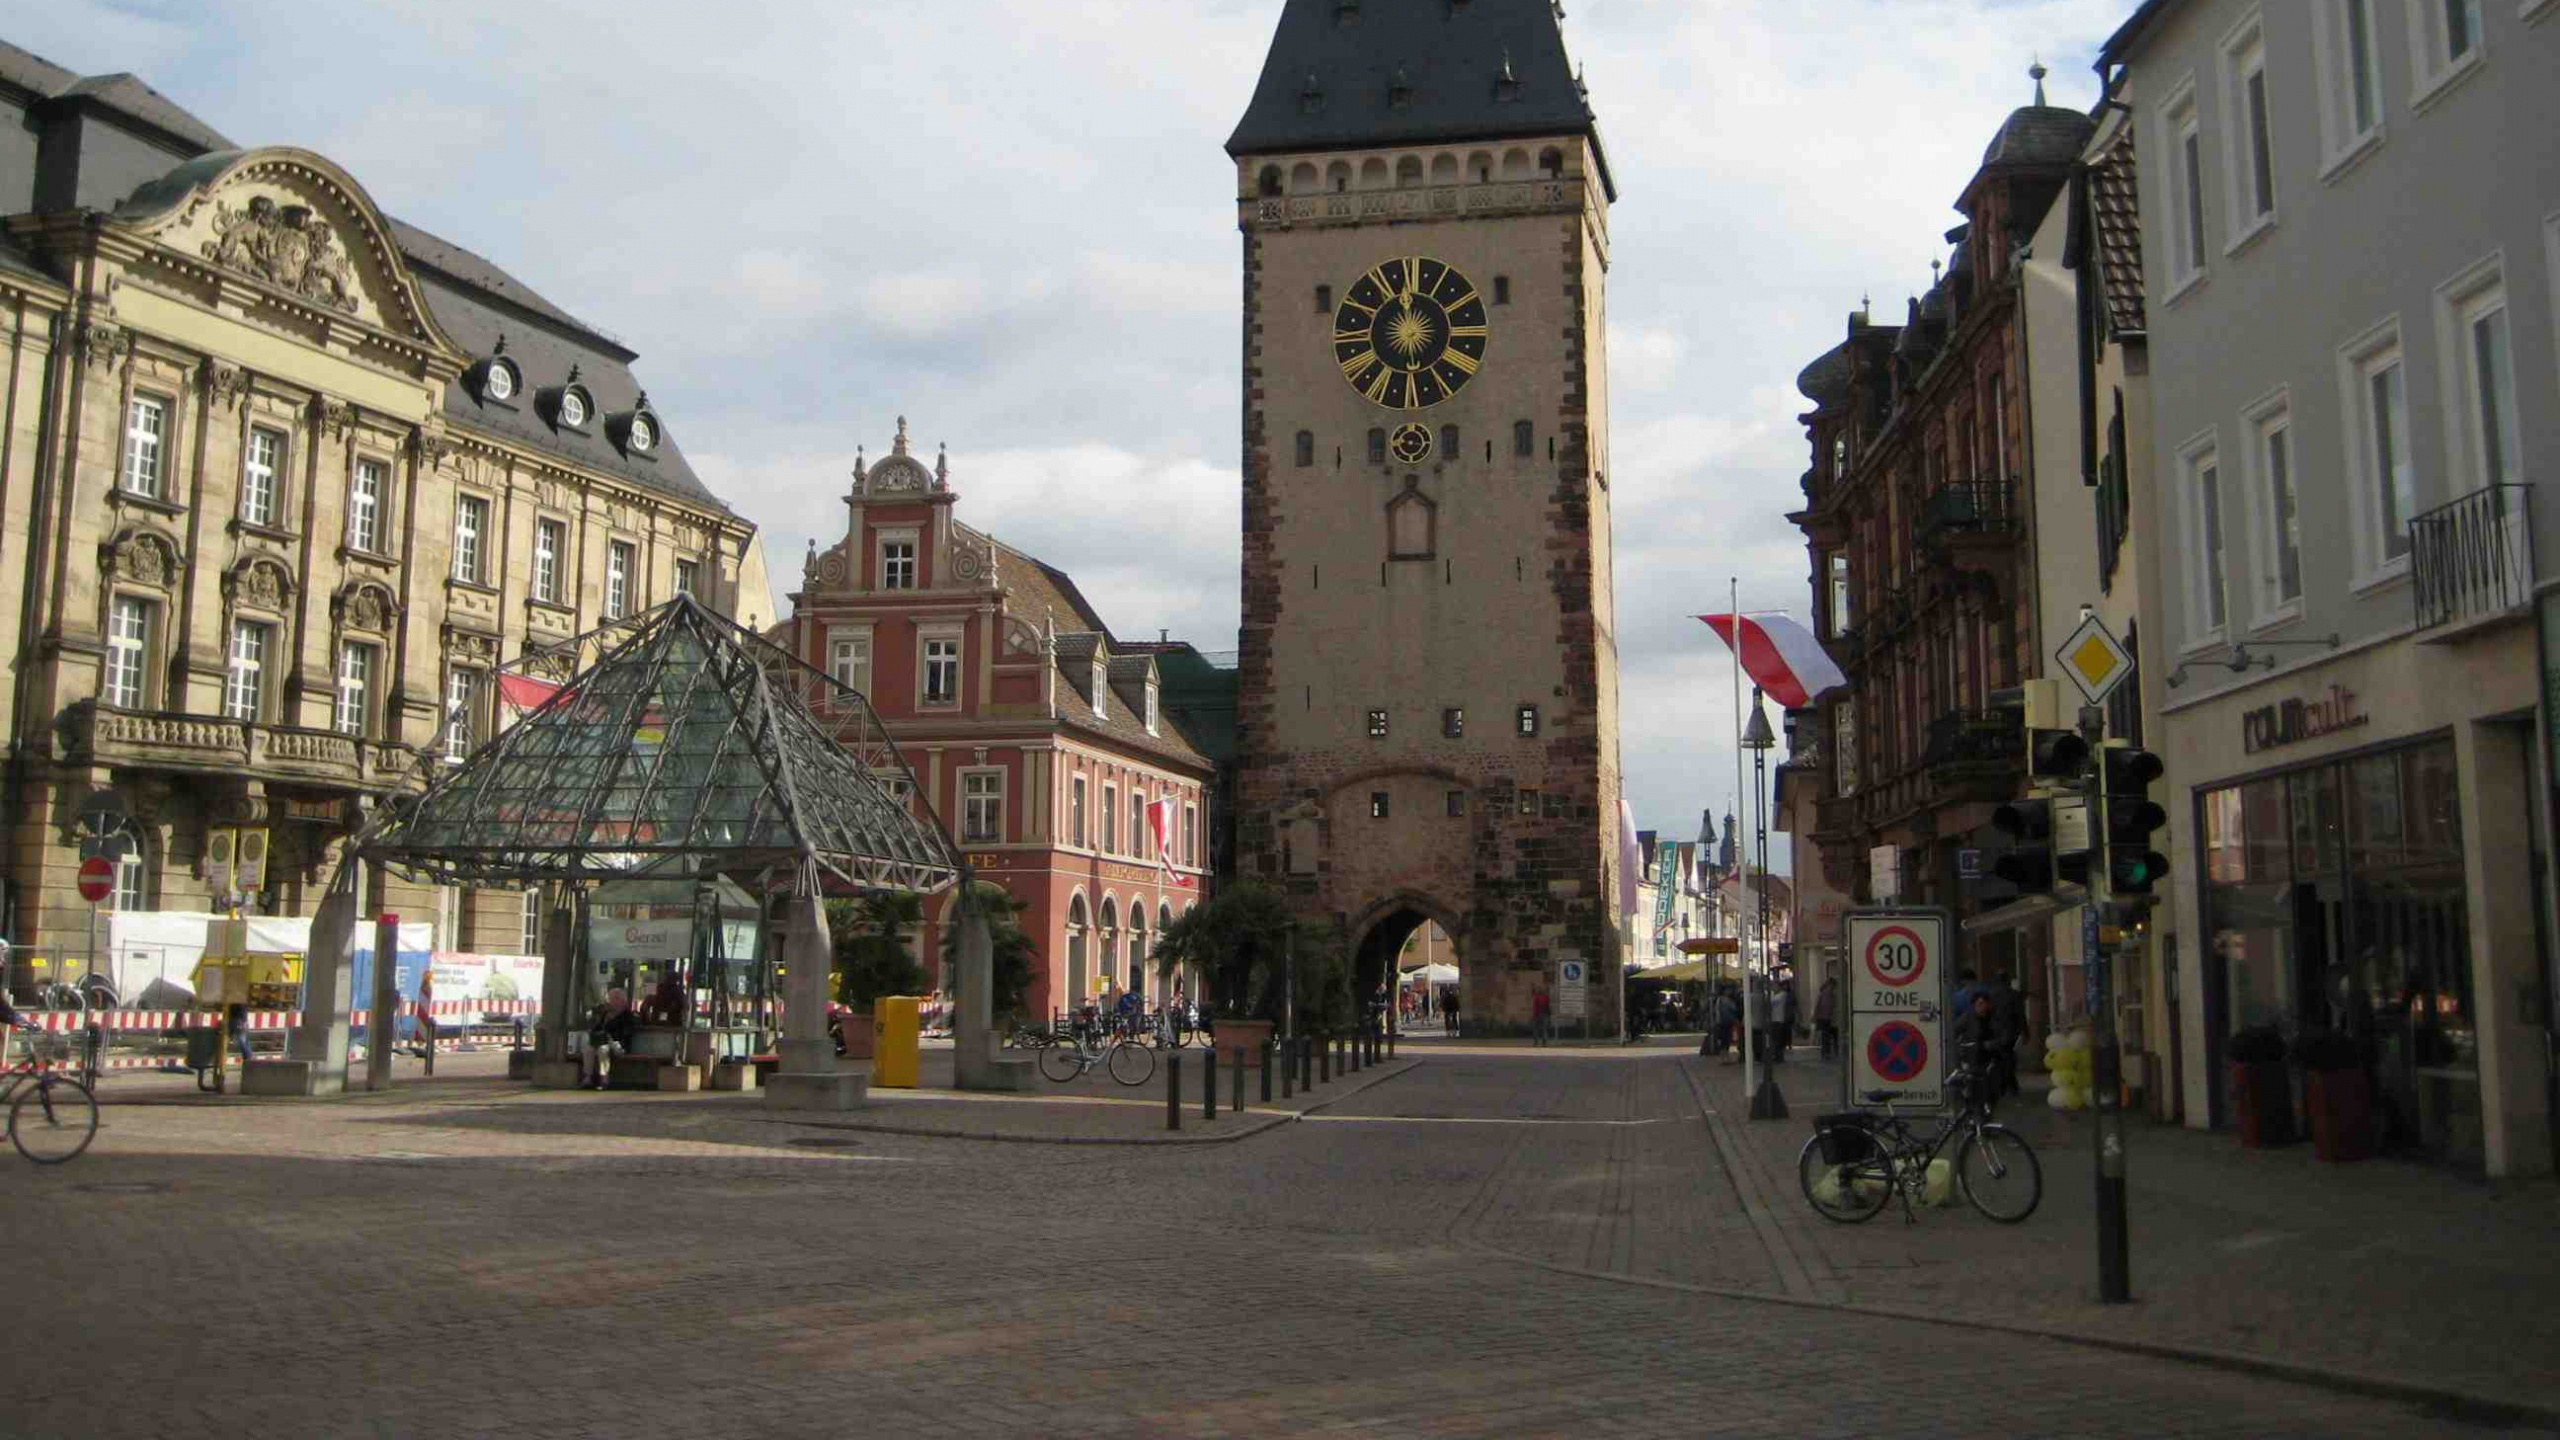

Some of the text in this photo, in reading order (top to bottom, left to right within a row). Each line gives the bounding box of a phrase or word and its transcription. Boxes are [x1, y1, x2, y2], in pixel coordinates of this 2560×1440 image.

[1446, 291, 1477, 314] II
[1451, 325, 1486, 337] III
[1878, 943, 1913, 971] 30
[1874, 991, 1919, 1006] ZONE
